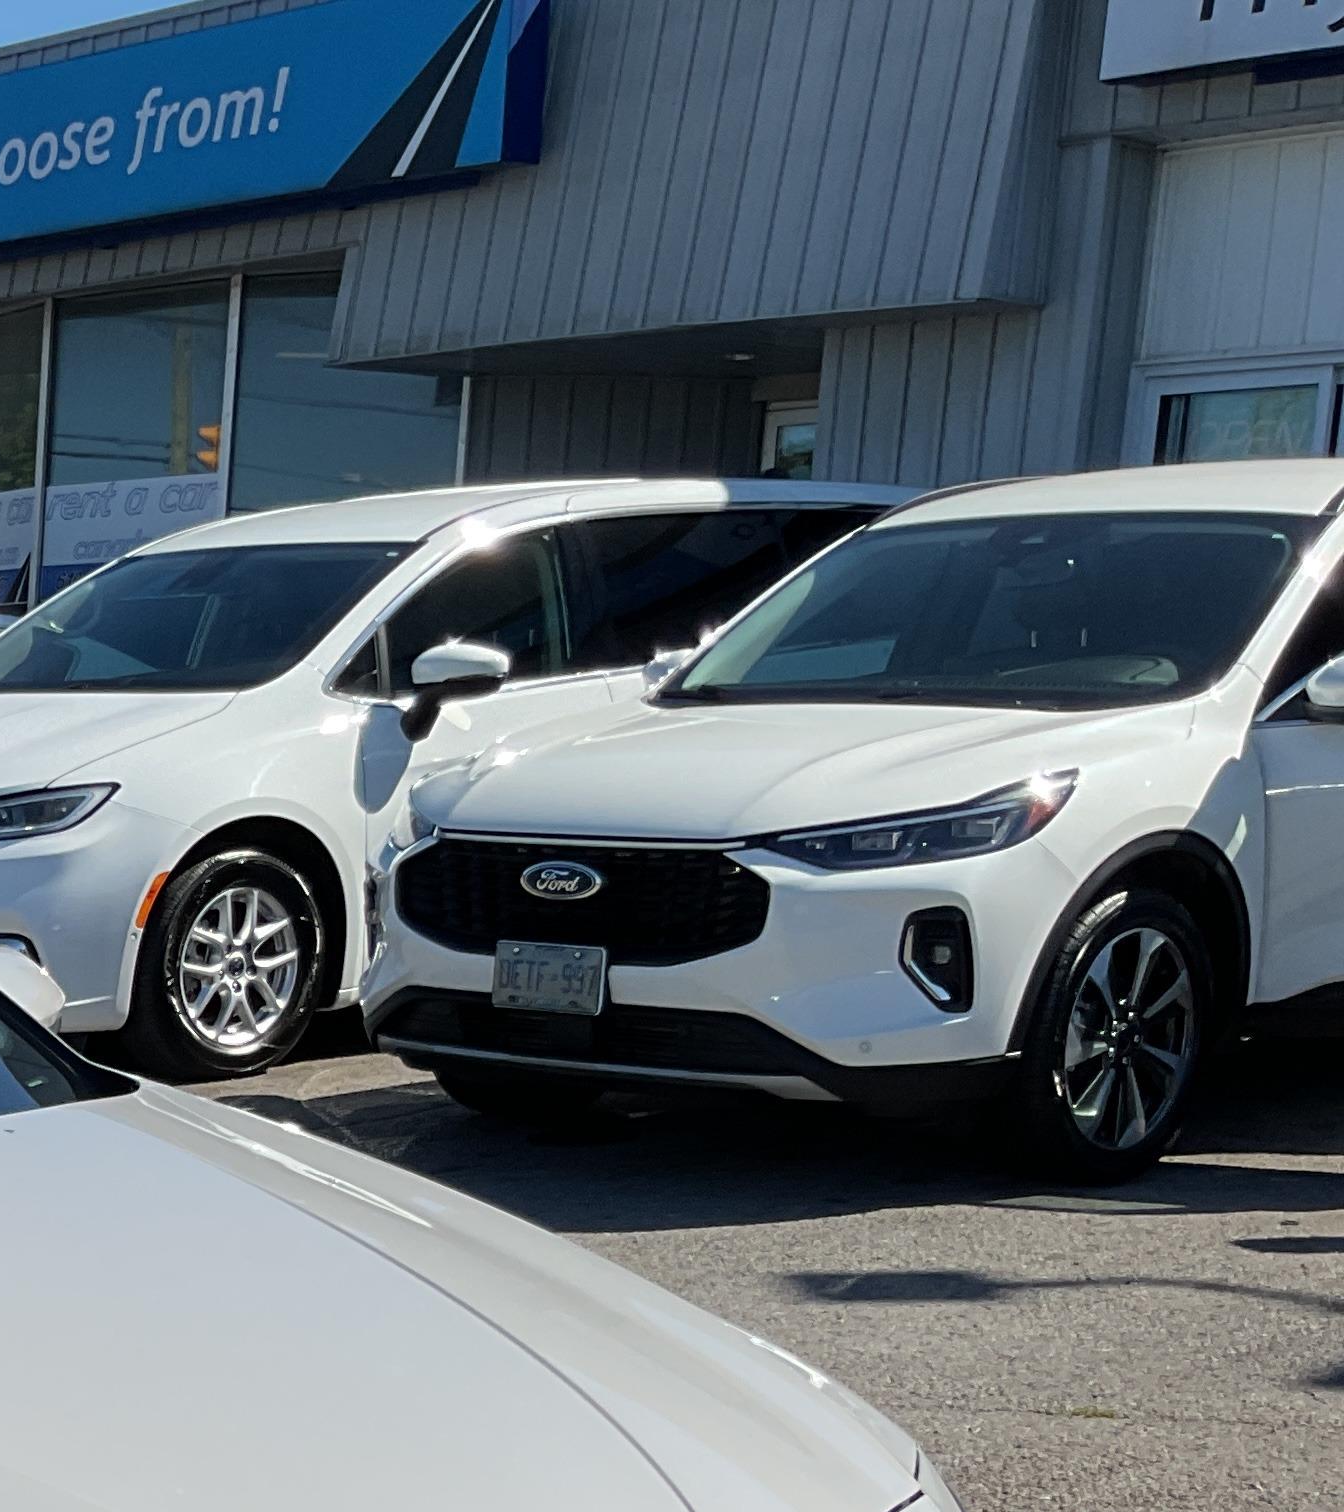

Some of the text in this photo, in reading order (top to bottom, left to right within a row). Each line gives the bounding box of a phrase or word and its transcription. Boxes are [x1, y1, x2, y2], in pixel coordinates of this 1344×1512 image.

[127, 66, 290, 176] from!
[45, 481, 220, 521] rent a car
[536, 869, 581, 892] Ford
